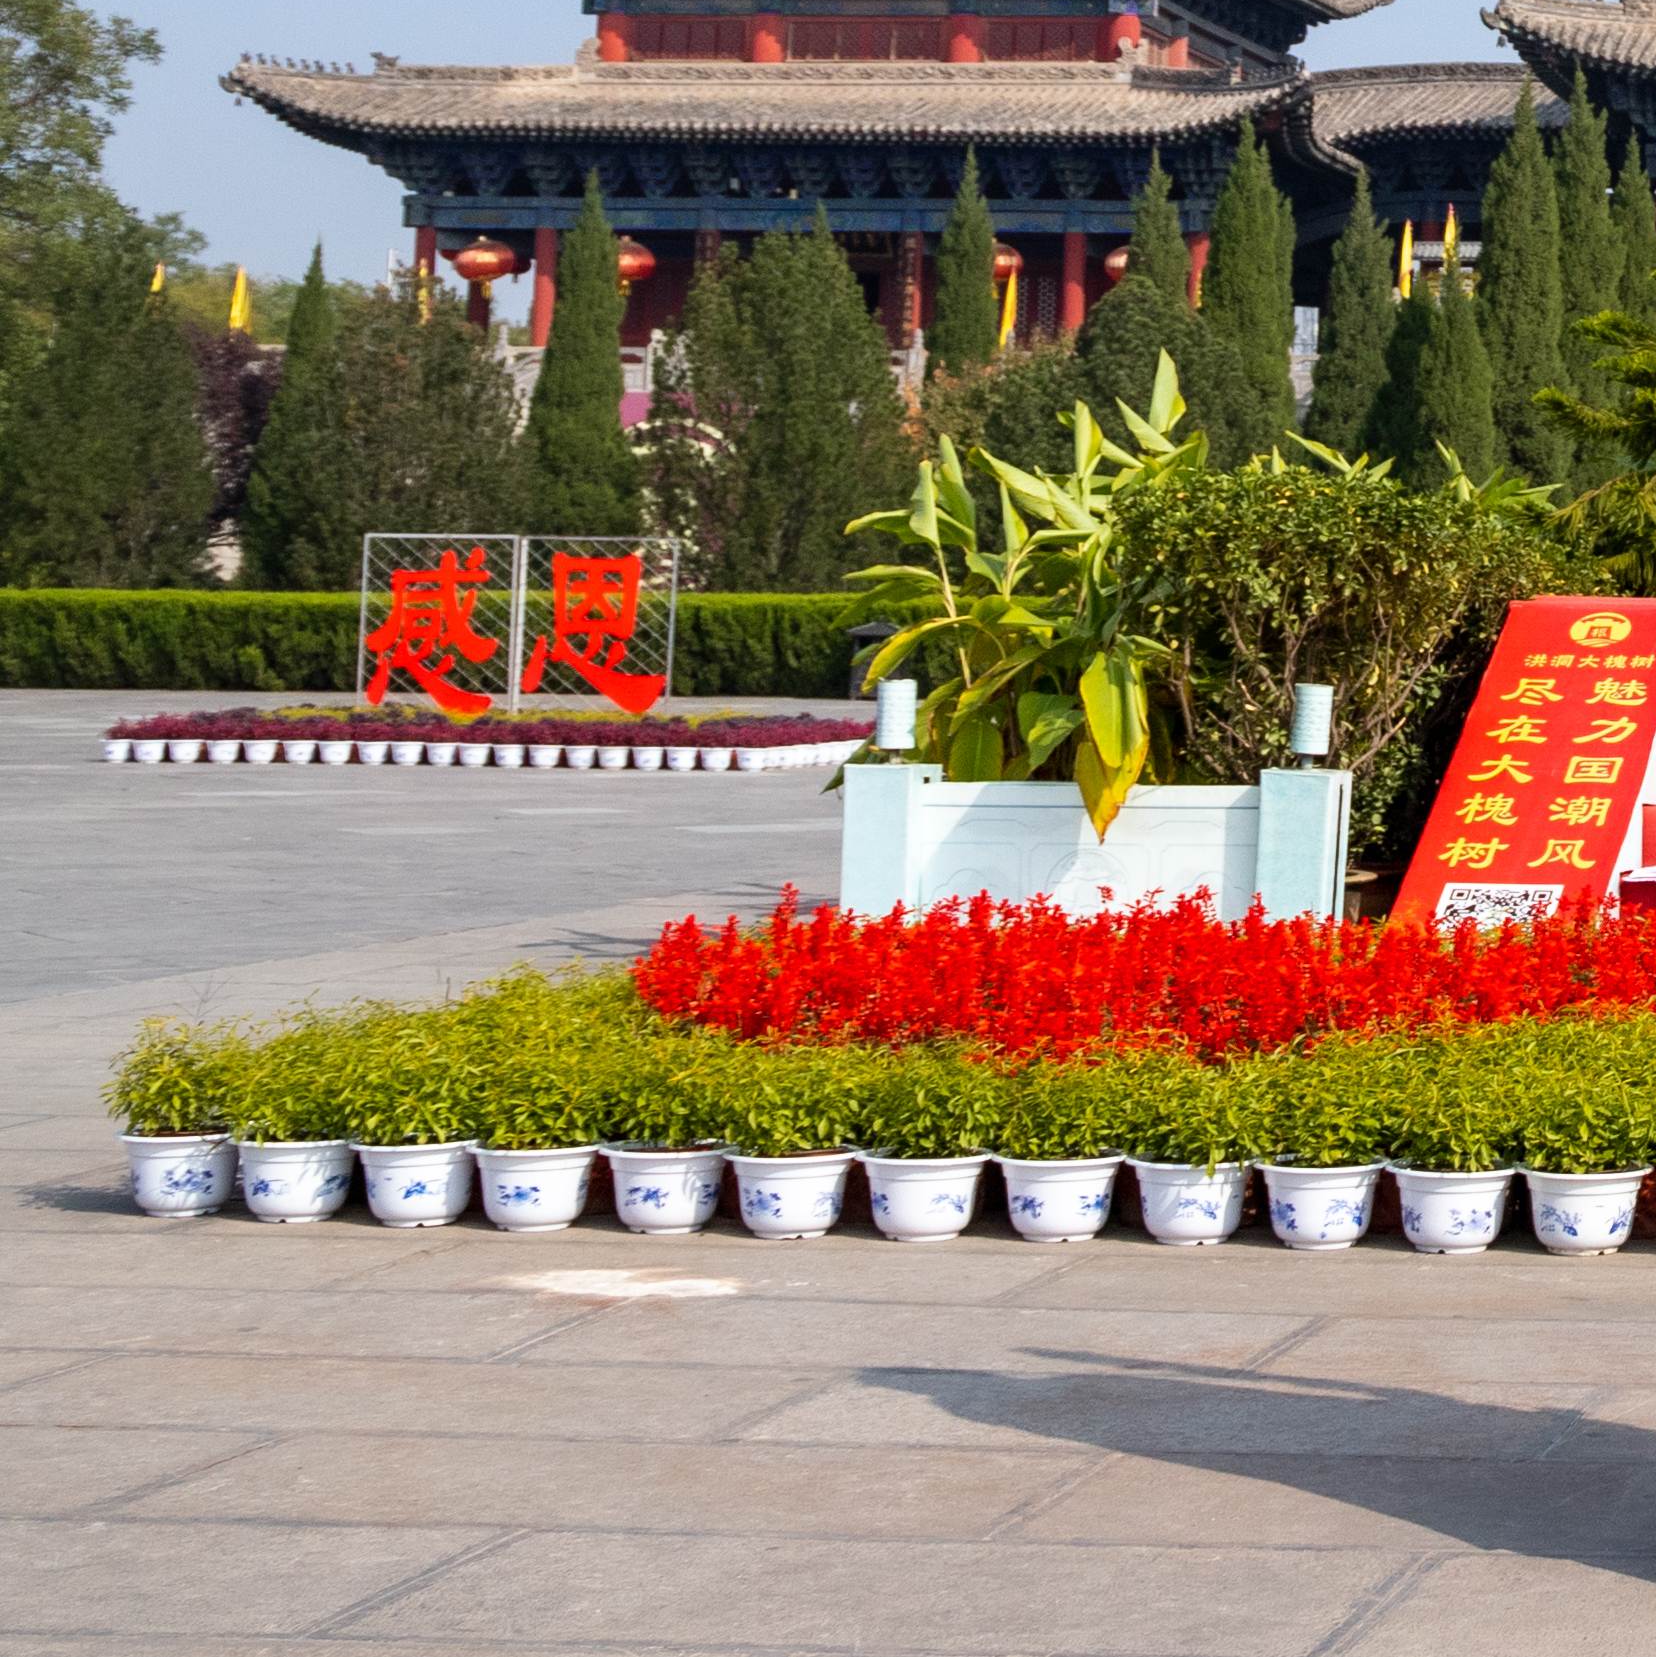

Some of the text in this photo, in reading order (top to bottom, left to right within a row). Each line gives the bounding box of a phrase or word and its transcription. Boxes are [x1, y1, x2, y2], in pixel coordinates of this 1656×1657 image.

[365, 546, 667, 715] 感恩
[1523, 653, 1656, 670] 洪洞大槐树
[1438, 677, 1564, 870] 尽在大槐树
[1527, 677, 1649, 870] 魅力国潮风
